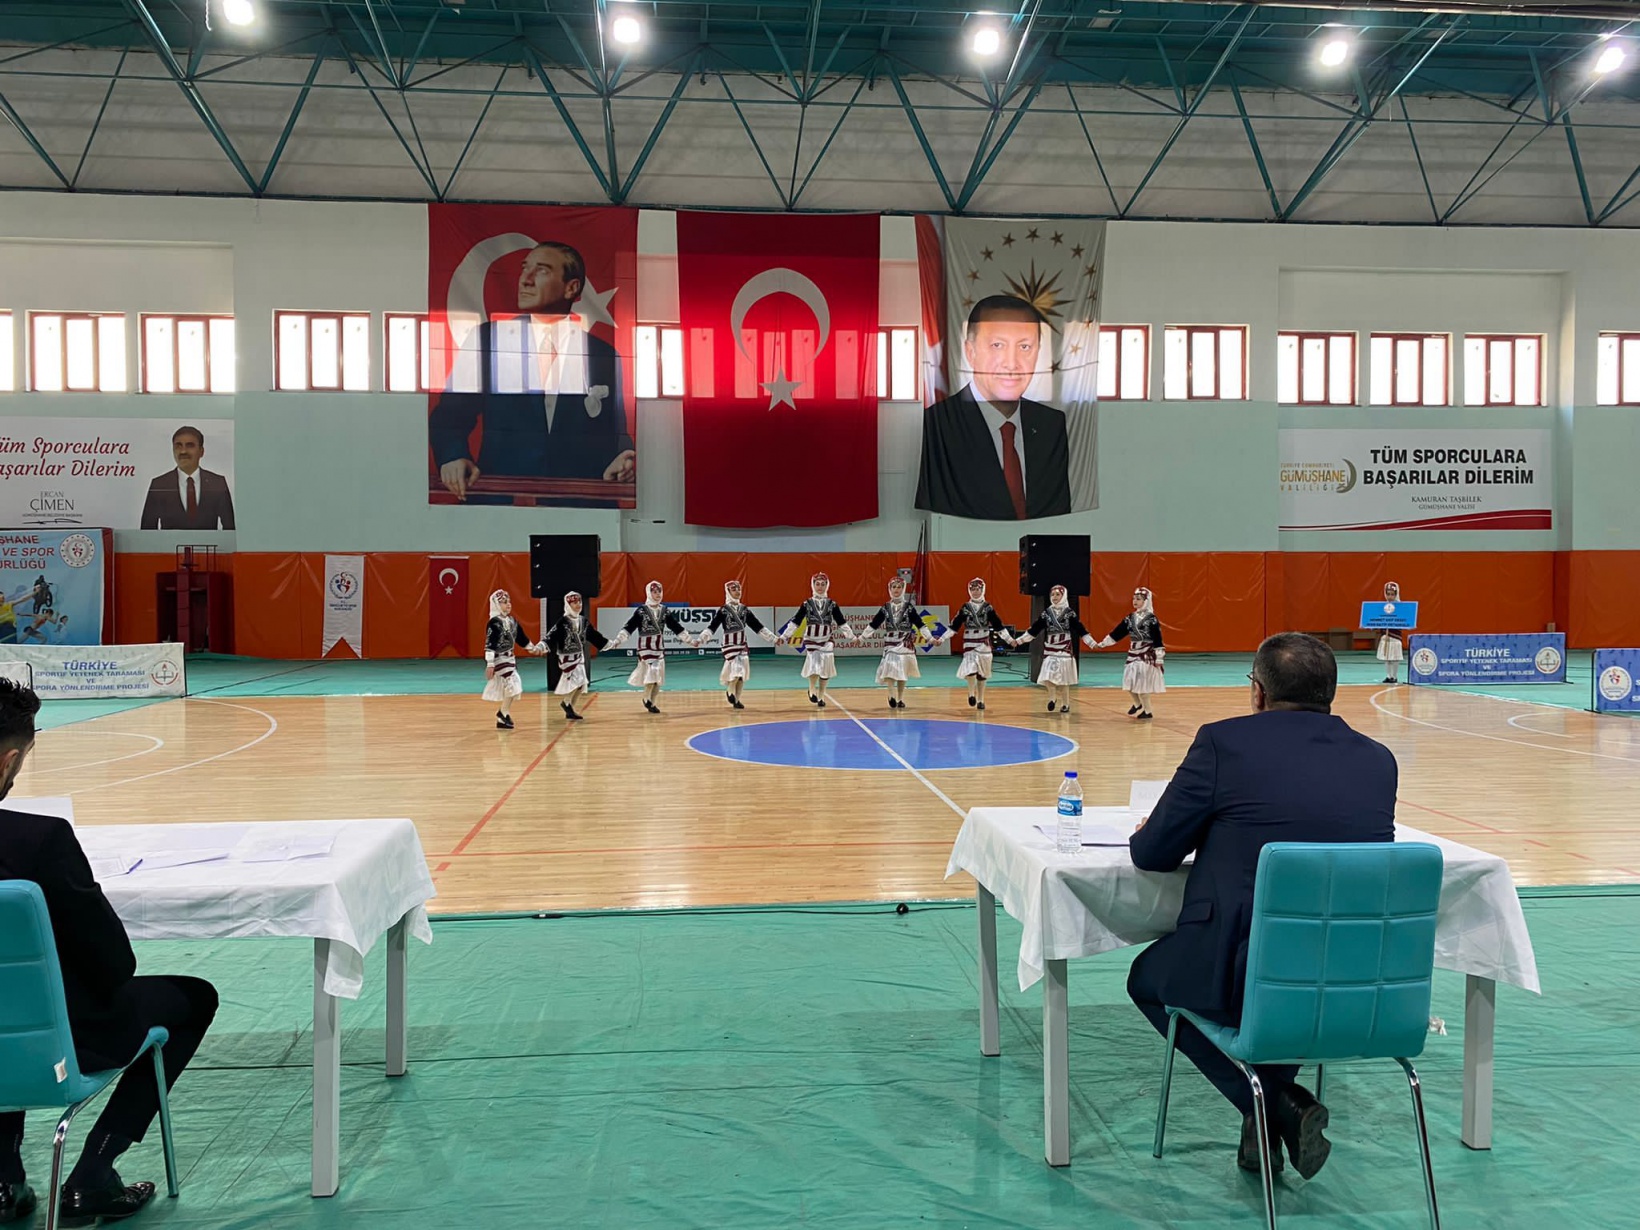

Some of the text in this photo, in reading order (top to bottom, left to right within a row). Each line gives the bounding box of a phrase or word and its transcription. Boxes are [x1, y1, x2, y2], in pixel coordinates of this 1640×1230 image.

[0, 437, 130, 459] üm Sporculara
[1370, 445, 1527, 464] TÜM SPORCULARA
[71, 459, 135, 476] Dilerim
[1363, 466, 1533, 489] BAŞARILAR DİLERİM
[3, 547, 54, 557] VE SPOR
[1464, 647, 1510, 657] TÜRKİYE
[62, 660, 118, 671] TÜRKİYE
